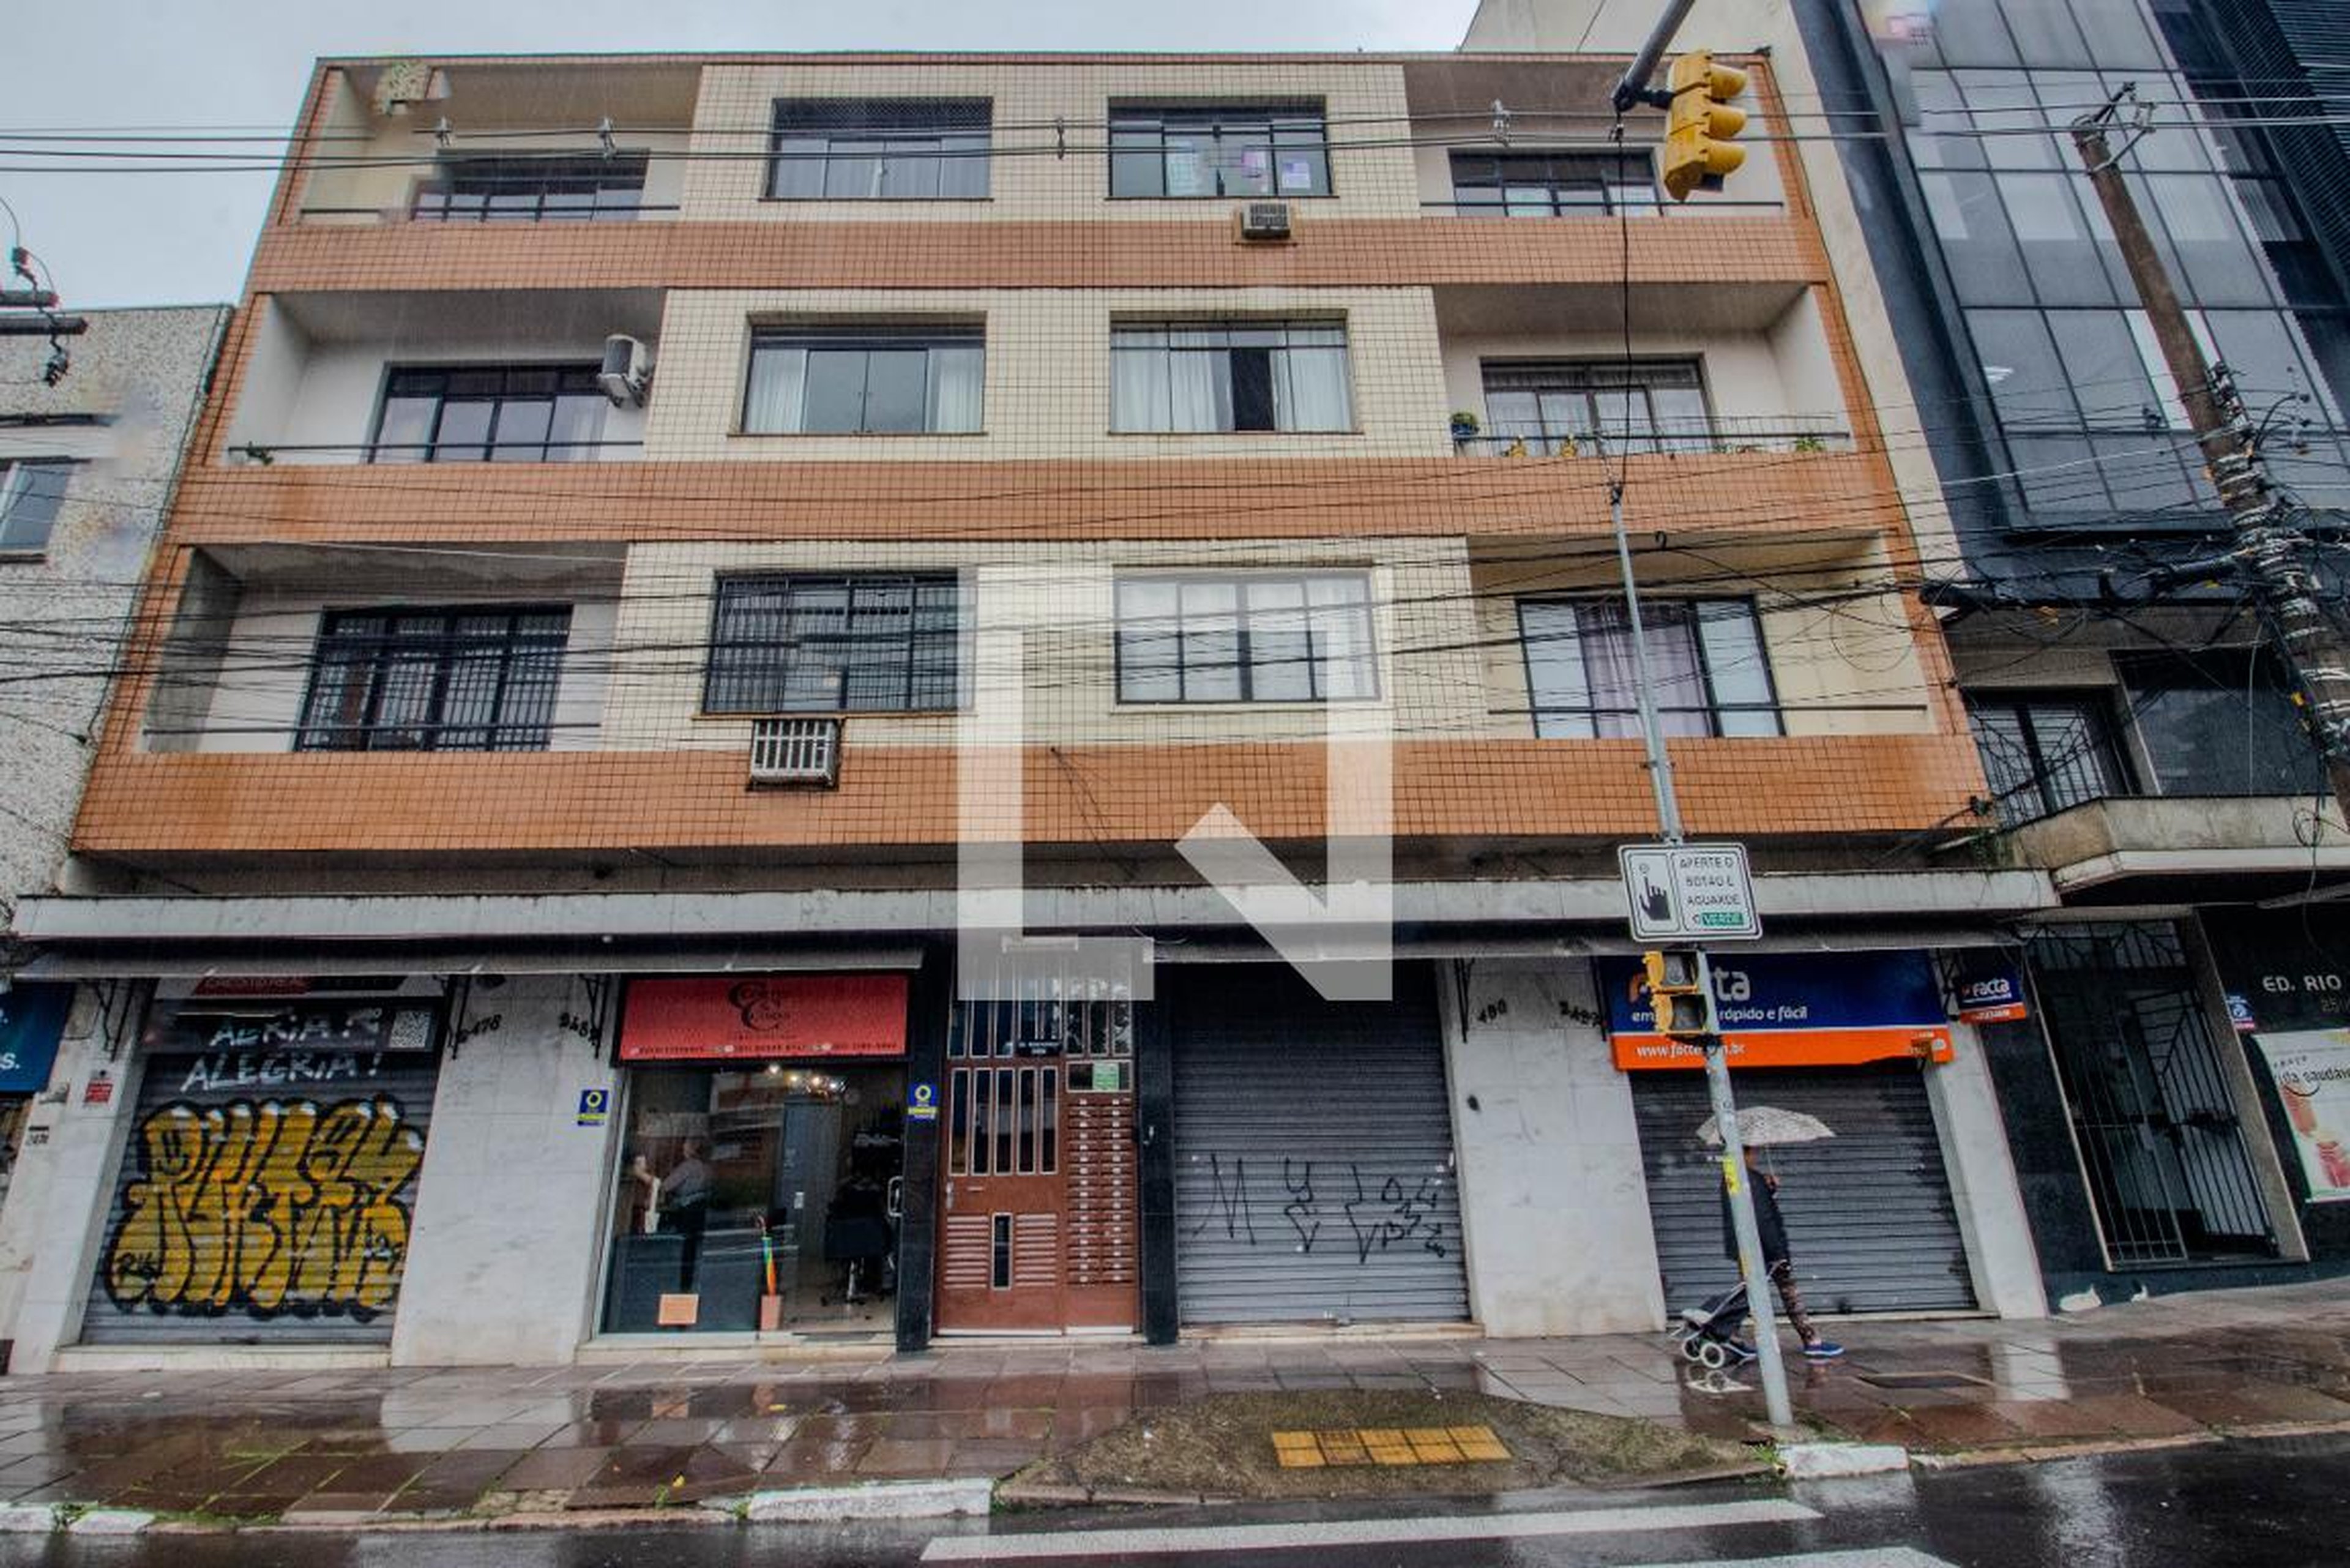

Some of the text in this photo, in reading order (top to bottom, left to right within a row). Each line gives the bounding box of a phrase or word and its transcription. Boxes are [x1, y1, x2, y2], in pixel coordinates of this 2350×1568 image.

[2262, 974, 2342, 991] ED. RIO
[1767, 1010, 1776, 1020] e
[1778, 1006, 1807, 1021] fácil
